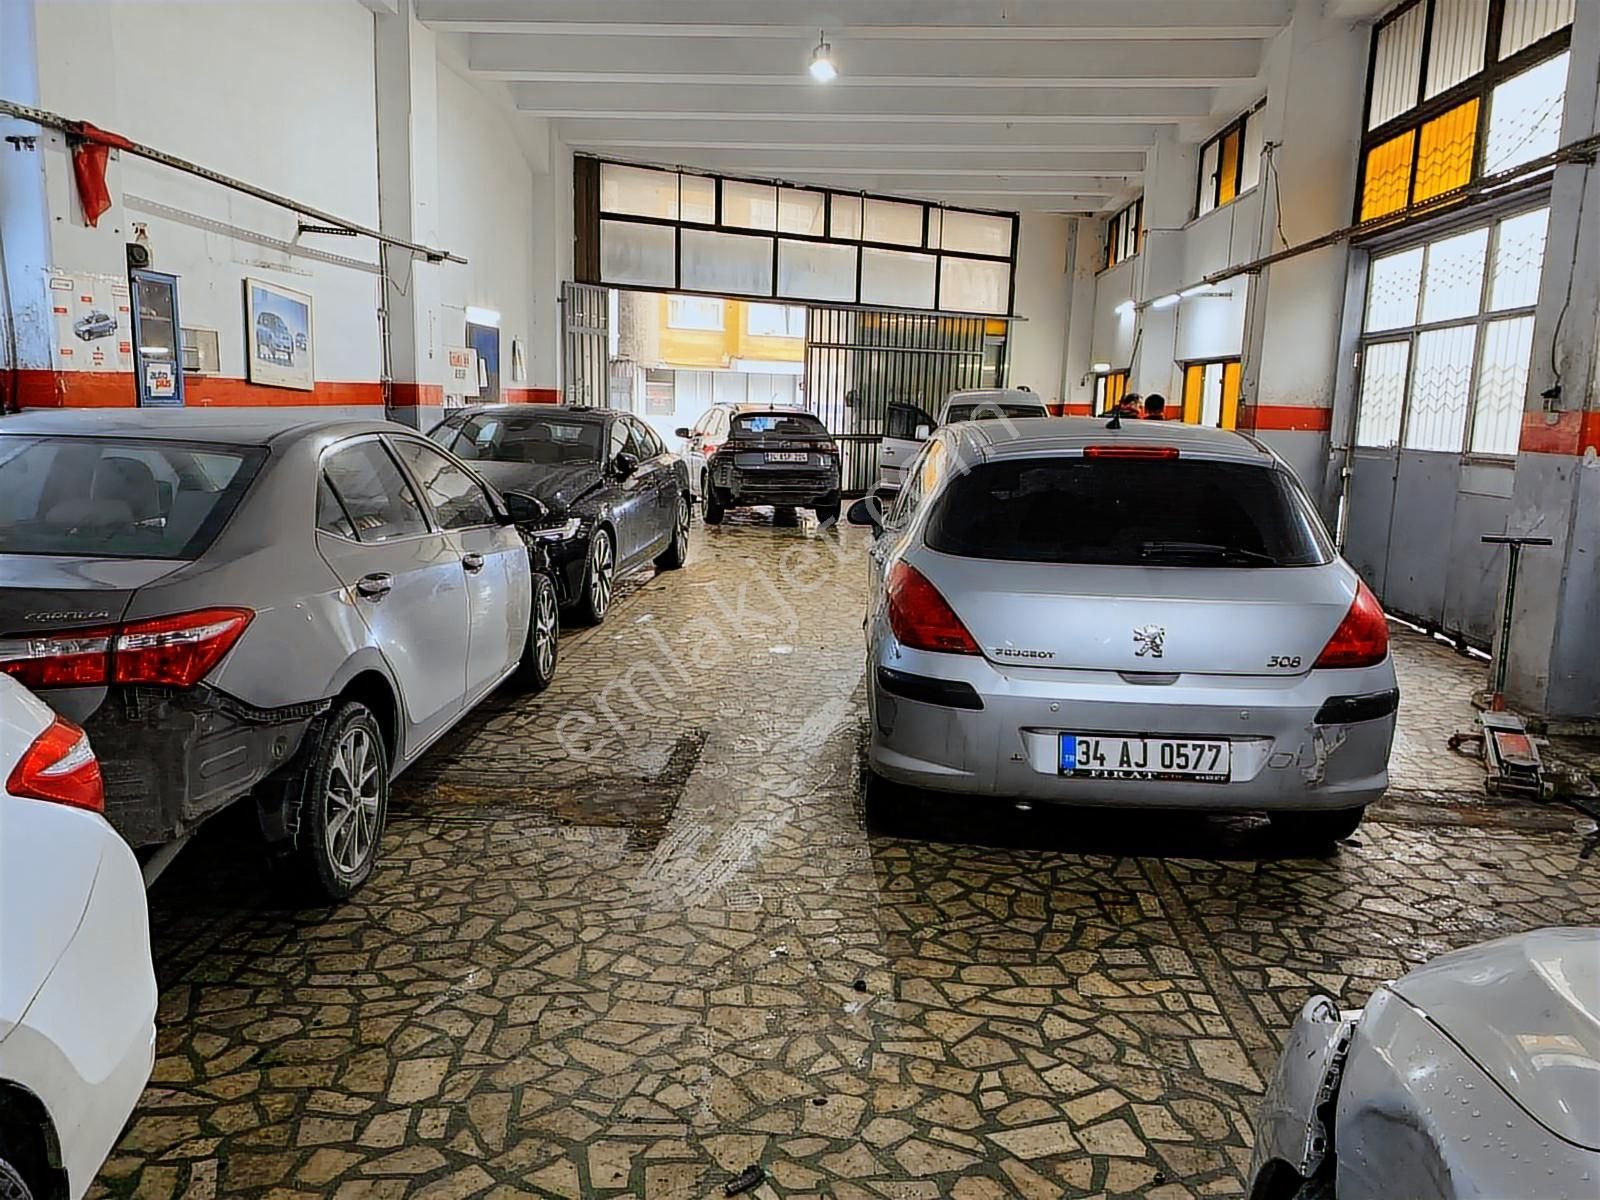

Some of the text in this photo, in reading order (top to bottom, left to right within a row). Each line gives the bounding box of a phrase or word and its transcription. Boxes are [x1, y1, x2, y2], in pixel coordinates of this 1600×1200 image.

[994, 648, 1056, 659] PEUGEOT
[1266, 655, 1302, 668] 308
[1077, 739, 1222, 771] 34 AJ 0577
